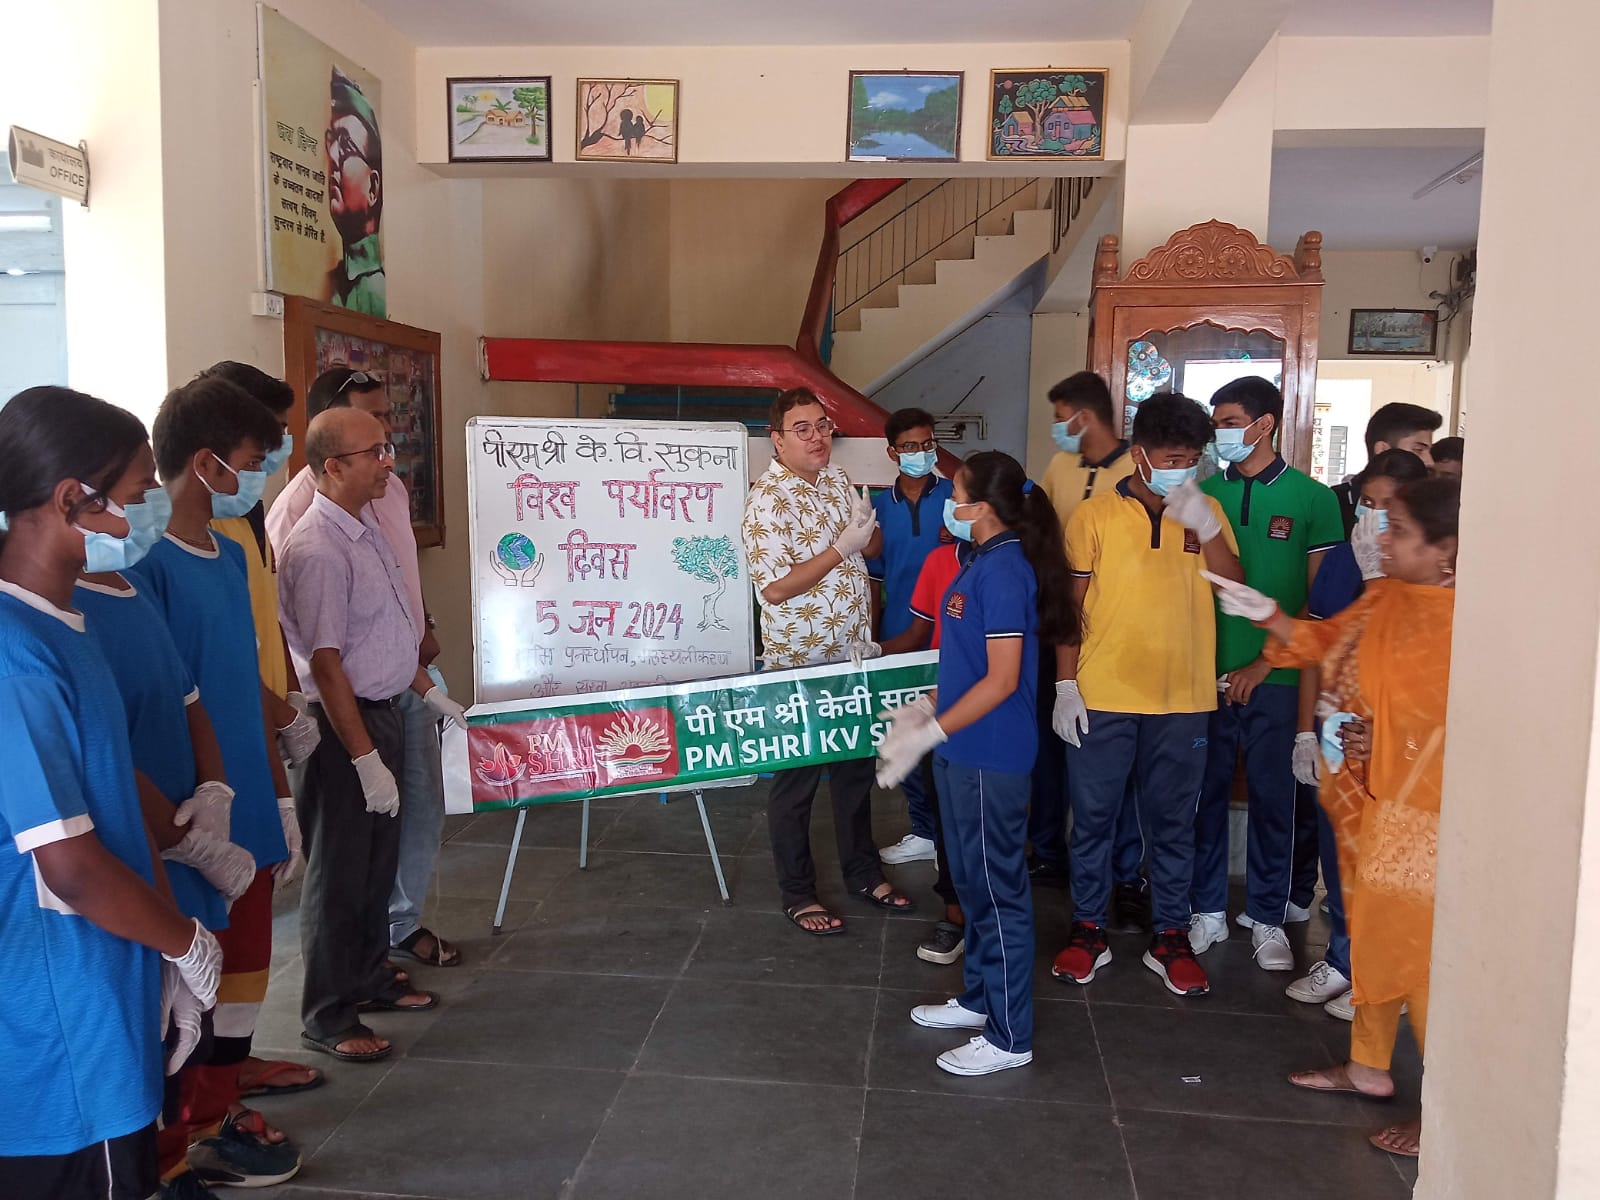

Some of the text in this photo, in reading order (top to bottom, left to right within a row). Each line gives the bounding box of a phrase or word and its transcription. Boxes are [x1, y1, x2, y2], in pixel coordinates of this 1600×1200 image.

[50, 166, 85, 187] OFFICE
[273, 171, 280, 185] के
[295, 163, 310, 178] मानव
[312, 170, 326, 186] जाति
[296, 221, 303, 235] से
[613, 431, 652, 463] वि.
[655, 441, 738, 472] सुकना
[506, 468, 724, 523] विश्व पर्यावरण
[558, 528, 637, 582] दिवस
[535, 600, 684, 642] 5 जून 2024
[685, 704, 716, 736] पी
[723, 705, 766, 737] एम
[774, 693, 810, 725] श्री
[816, 685, 872, 719] केवी
[526, 733, 565, 754] PM
[528, 746, 596, 776] SHRI
[685, 741, 734, 771] PM
[741, 731, 811, 764] SHRI
[819, 725, 861, 754] KV
